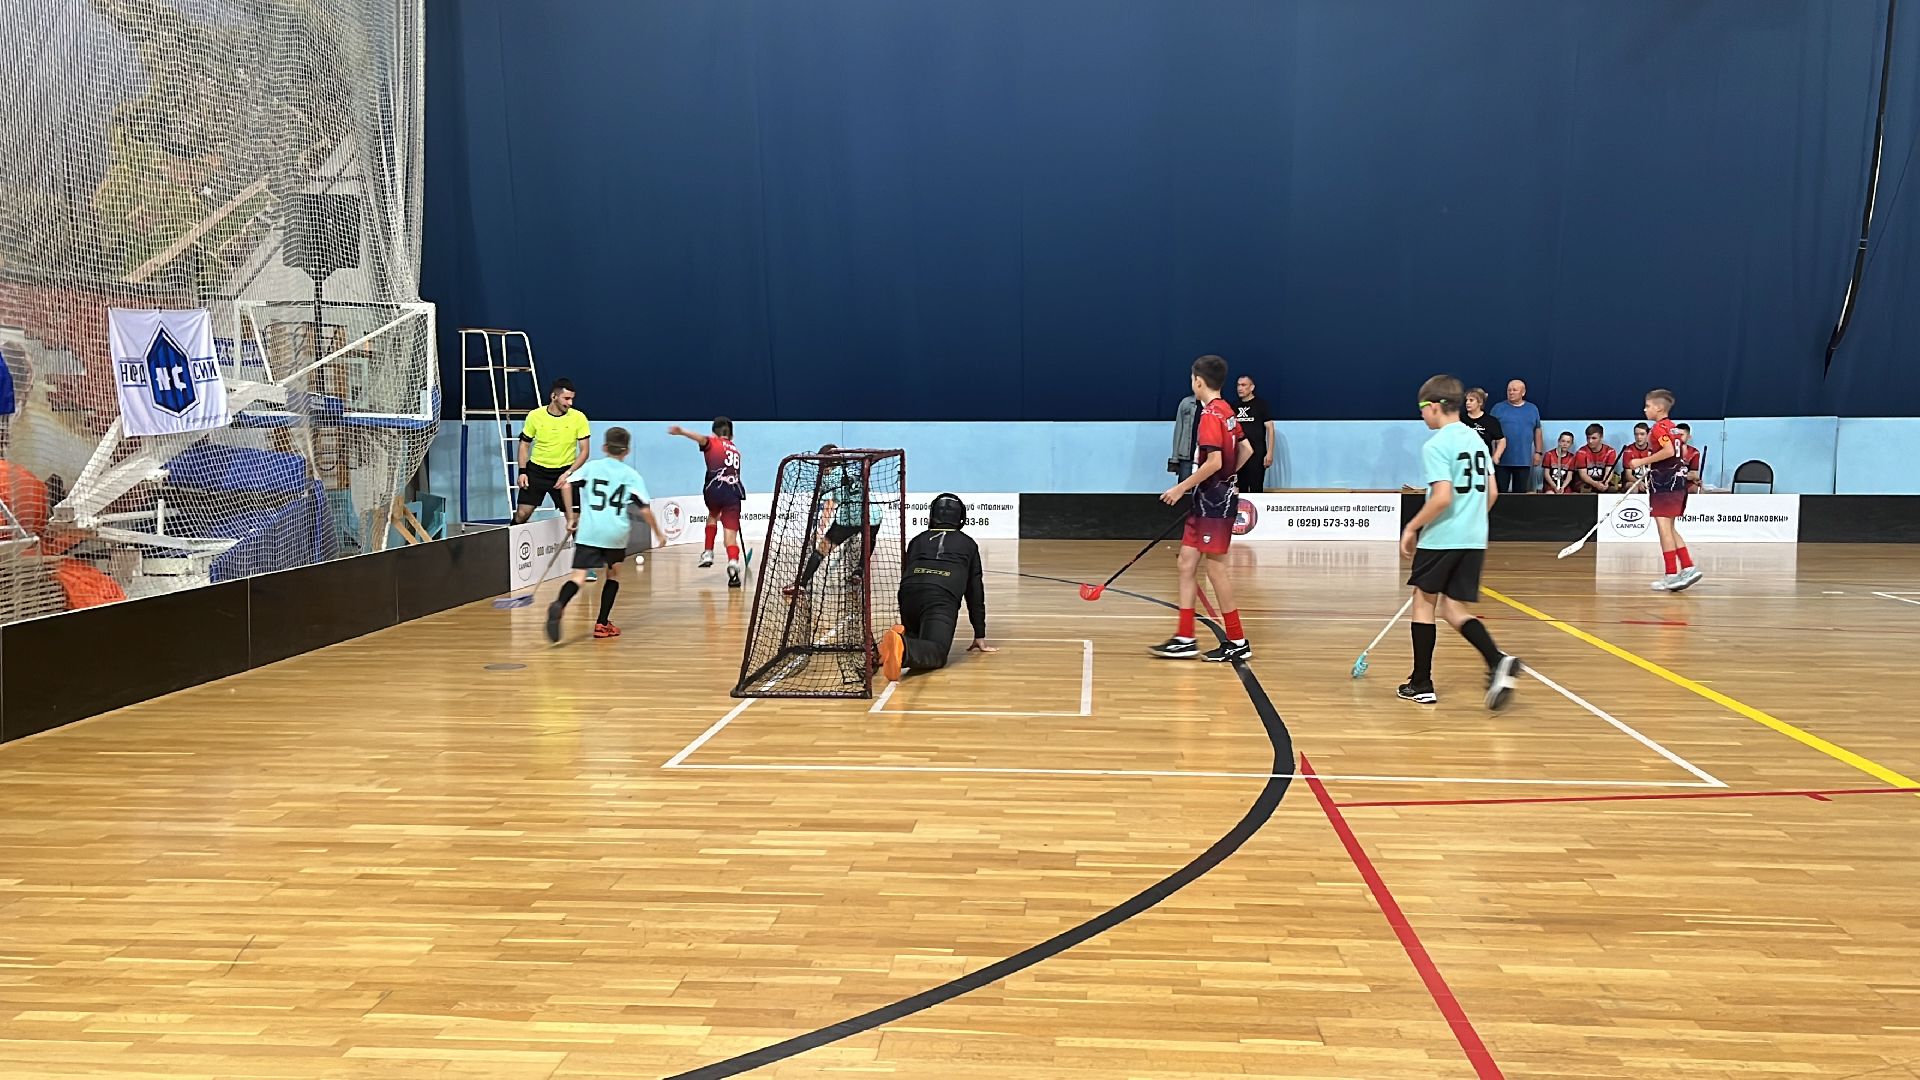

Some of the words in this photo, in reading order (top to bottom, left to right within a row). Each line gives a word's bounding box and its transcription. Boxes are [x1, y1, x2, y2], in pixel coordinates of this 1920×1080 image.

[1454, 450, 1486, 494] 39
[590, 478, 625, 516] 54
[1266, 504, 1329, 512] Развлекательный
[912, 517, 918, 526] 8
[1287, 518, 1294, 527] 8
[1296, 518, 1321, 528] (929)
[1323, 518, 1370, 528] 573-33-86
[1717, 513, 1742, 523] Завод
